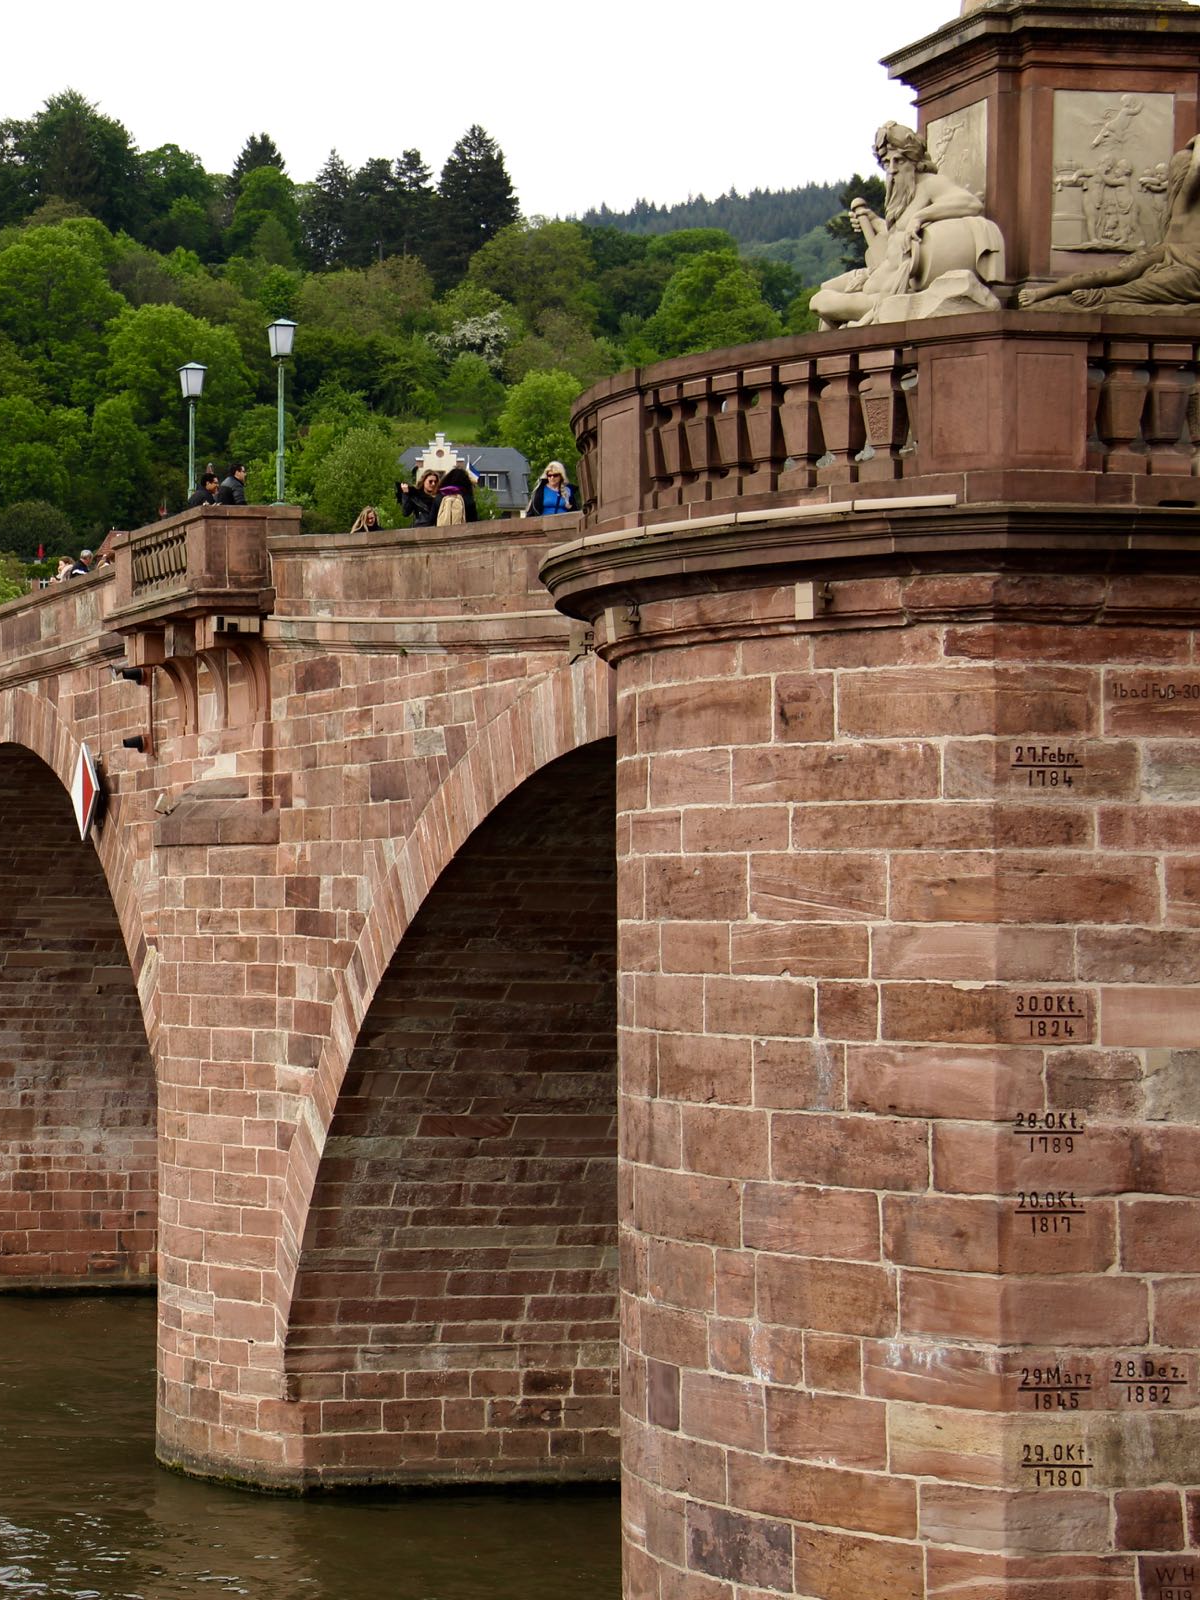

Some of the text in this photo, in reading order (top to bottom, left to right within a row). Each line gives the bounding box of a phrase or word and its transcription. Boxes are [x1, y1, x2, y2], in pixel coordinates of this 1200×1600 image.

[1014, 746, 1079, 763] 27.Febr.
[1028, 771, 1073, 787] 1784
[1030, 1020, 1074, 1037] 1824
[1030, 1137, 1074, 1153] 1789
[1031, 1216, 1071, 1234] 1817
[1021, 1367, 1092, 1386] 29.März
[1114, 1361, 1185, 1379] 28.Dez.
[1034, 1392, 1079, 1409] 1845
[1127, 1386, 1171, 1403] 1882
[1036, 1470, 1082, 1487] 1780
